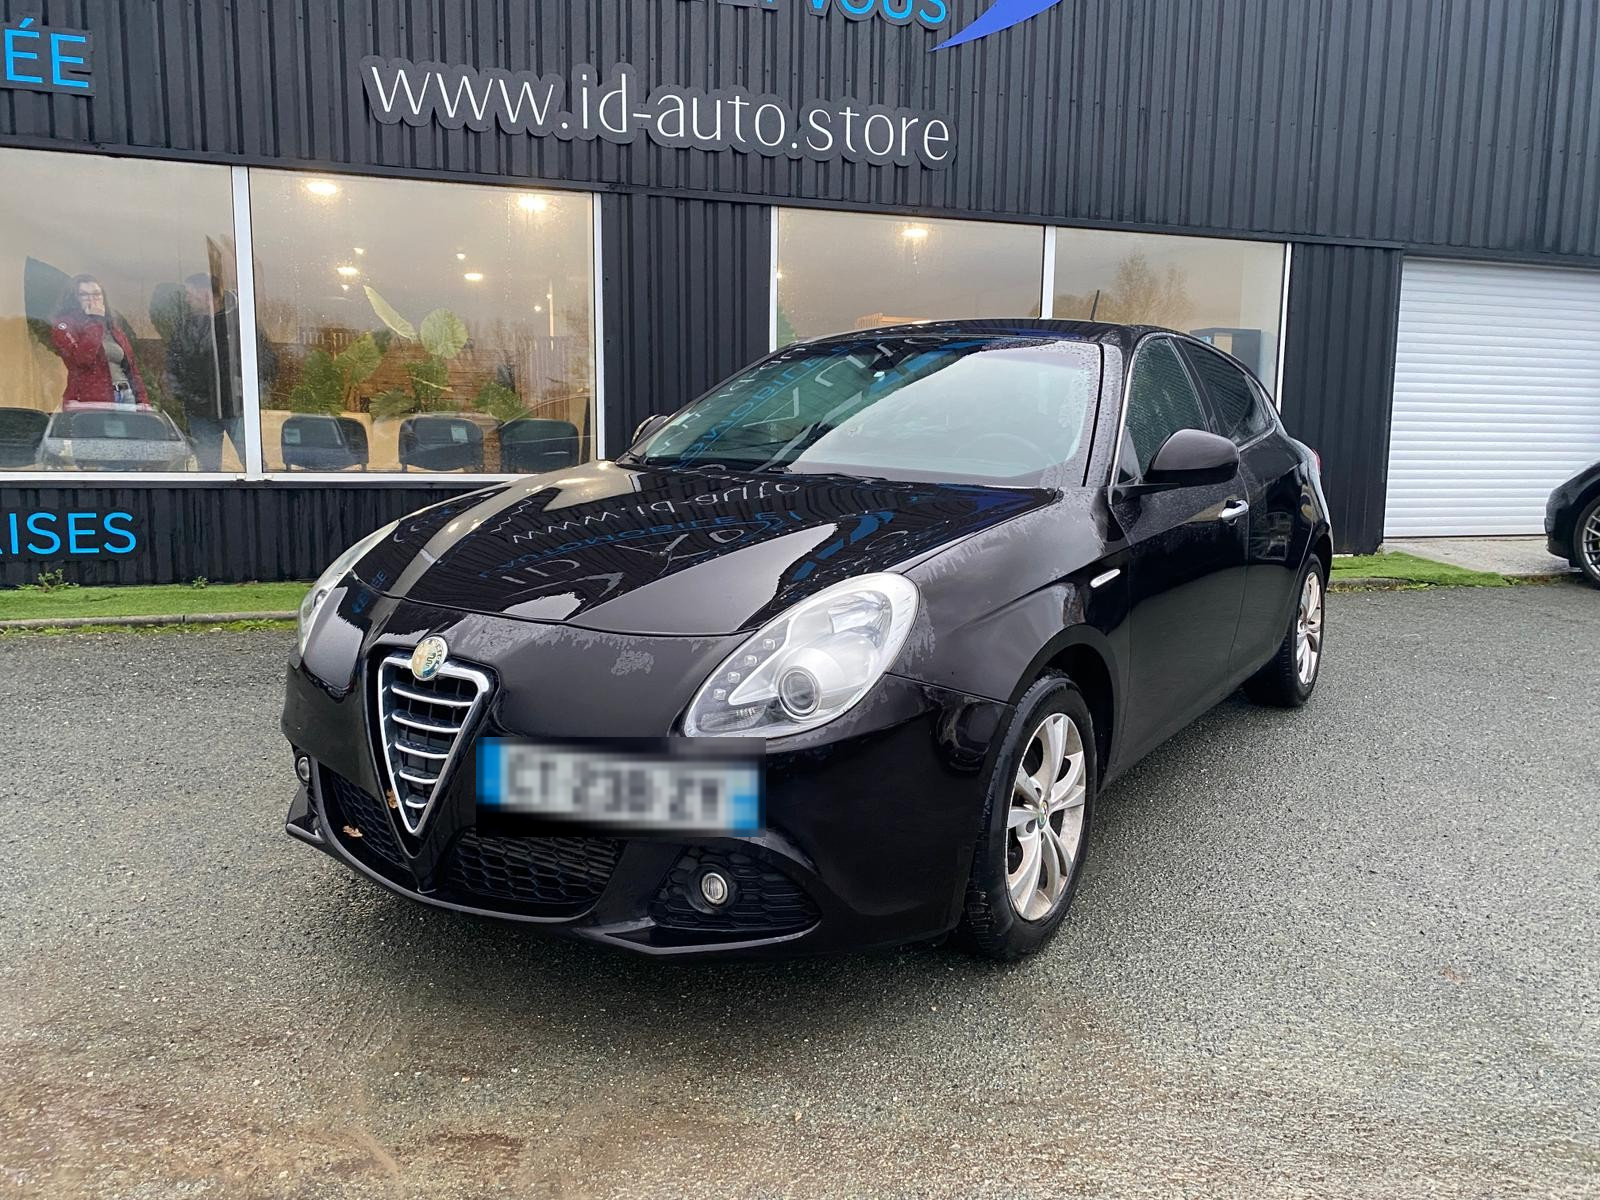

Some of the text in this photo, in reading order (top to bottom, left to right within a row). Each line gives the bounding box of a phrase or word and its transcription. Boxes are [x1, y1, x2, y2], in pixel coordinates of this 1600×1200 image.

[4, 17, 90, 88] ÉE
[370, 65, 950, 162] www.id-auto.store
[0, 511, 138, 556] ISES
